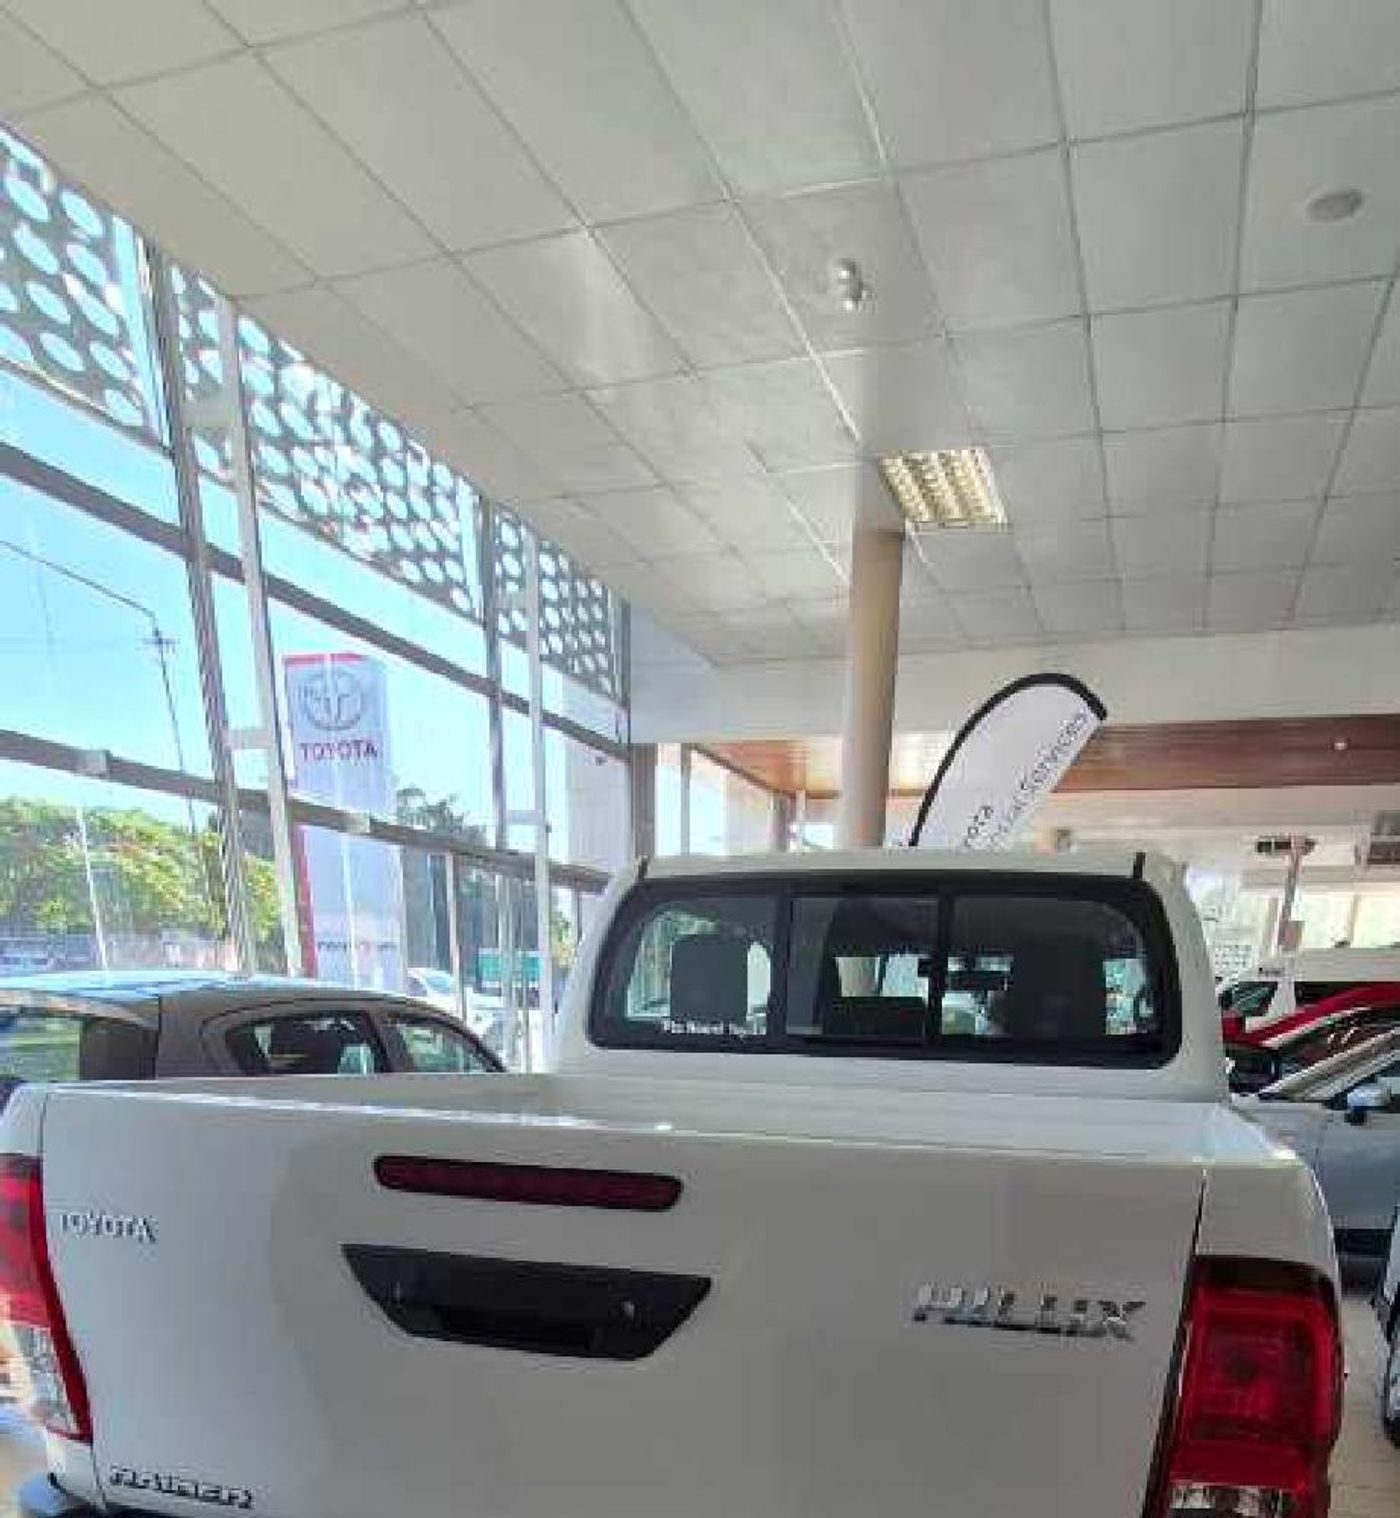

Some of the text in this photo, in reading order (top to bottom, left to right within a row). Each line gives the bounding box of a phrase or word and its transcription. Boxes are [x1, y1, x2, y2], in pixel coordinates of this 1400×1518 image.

[300, 739, 378, 761] TOYOTA
[61, 1212, 157, 1244] TOYOTA
[911, 1284, 1147, 1342] HILUX
[109, 1464, 254, 1509] RAIDER
